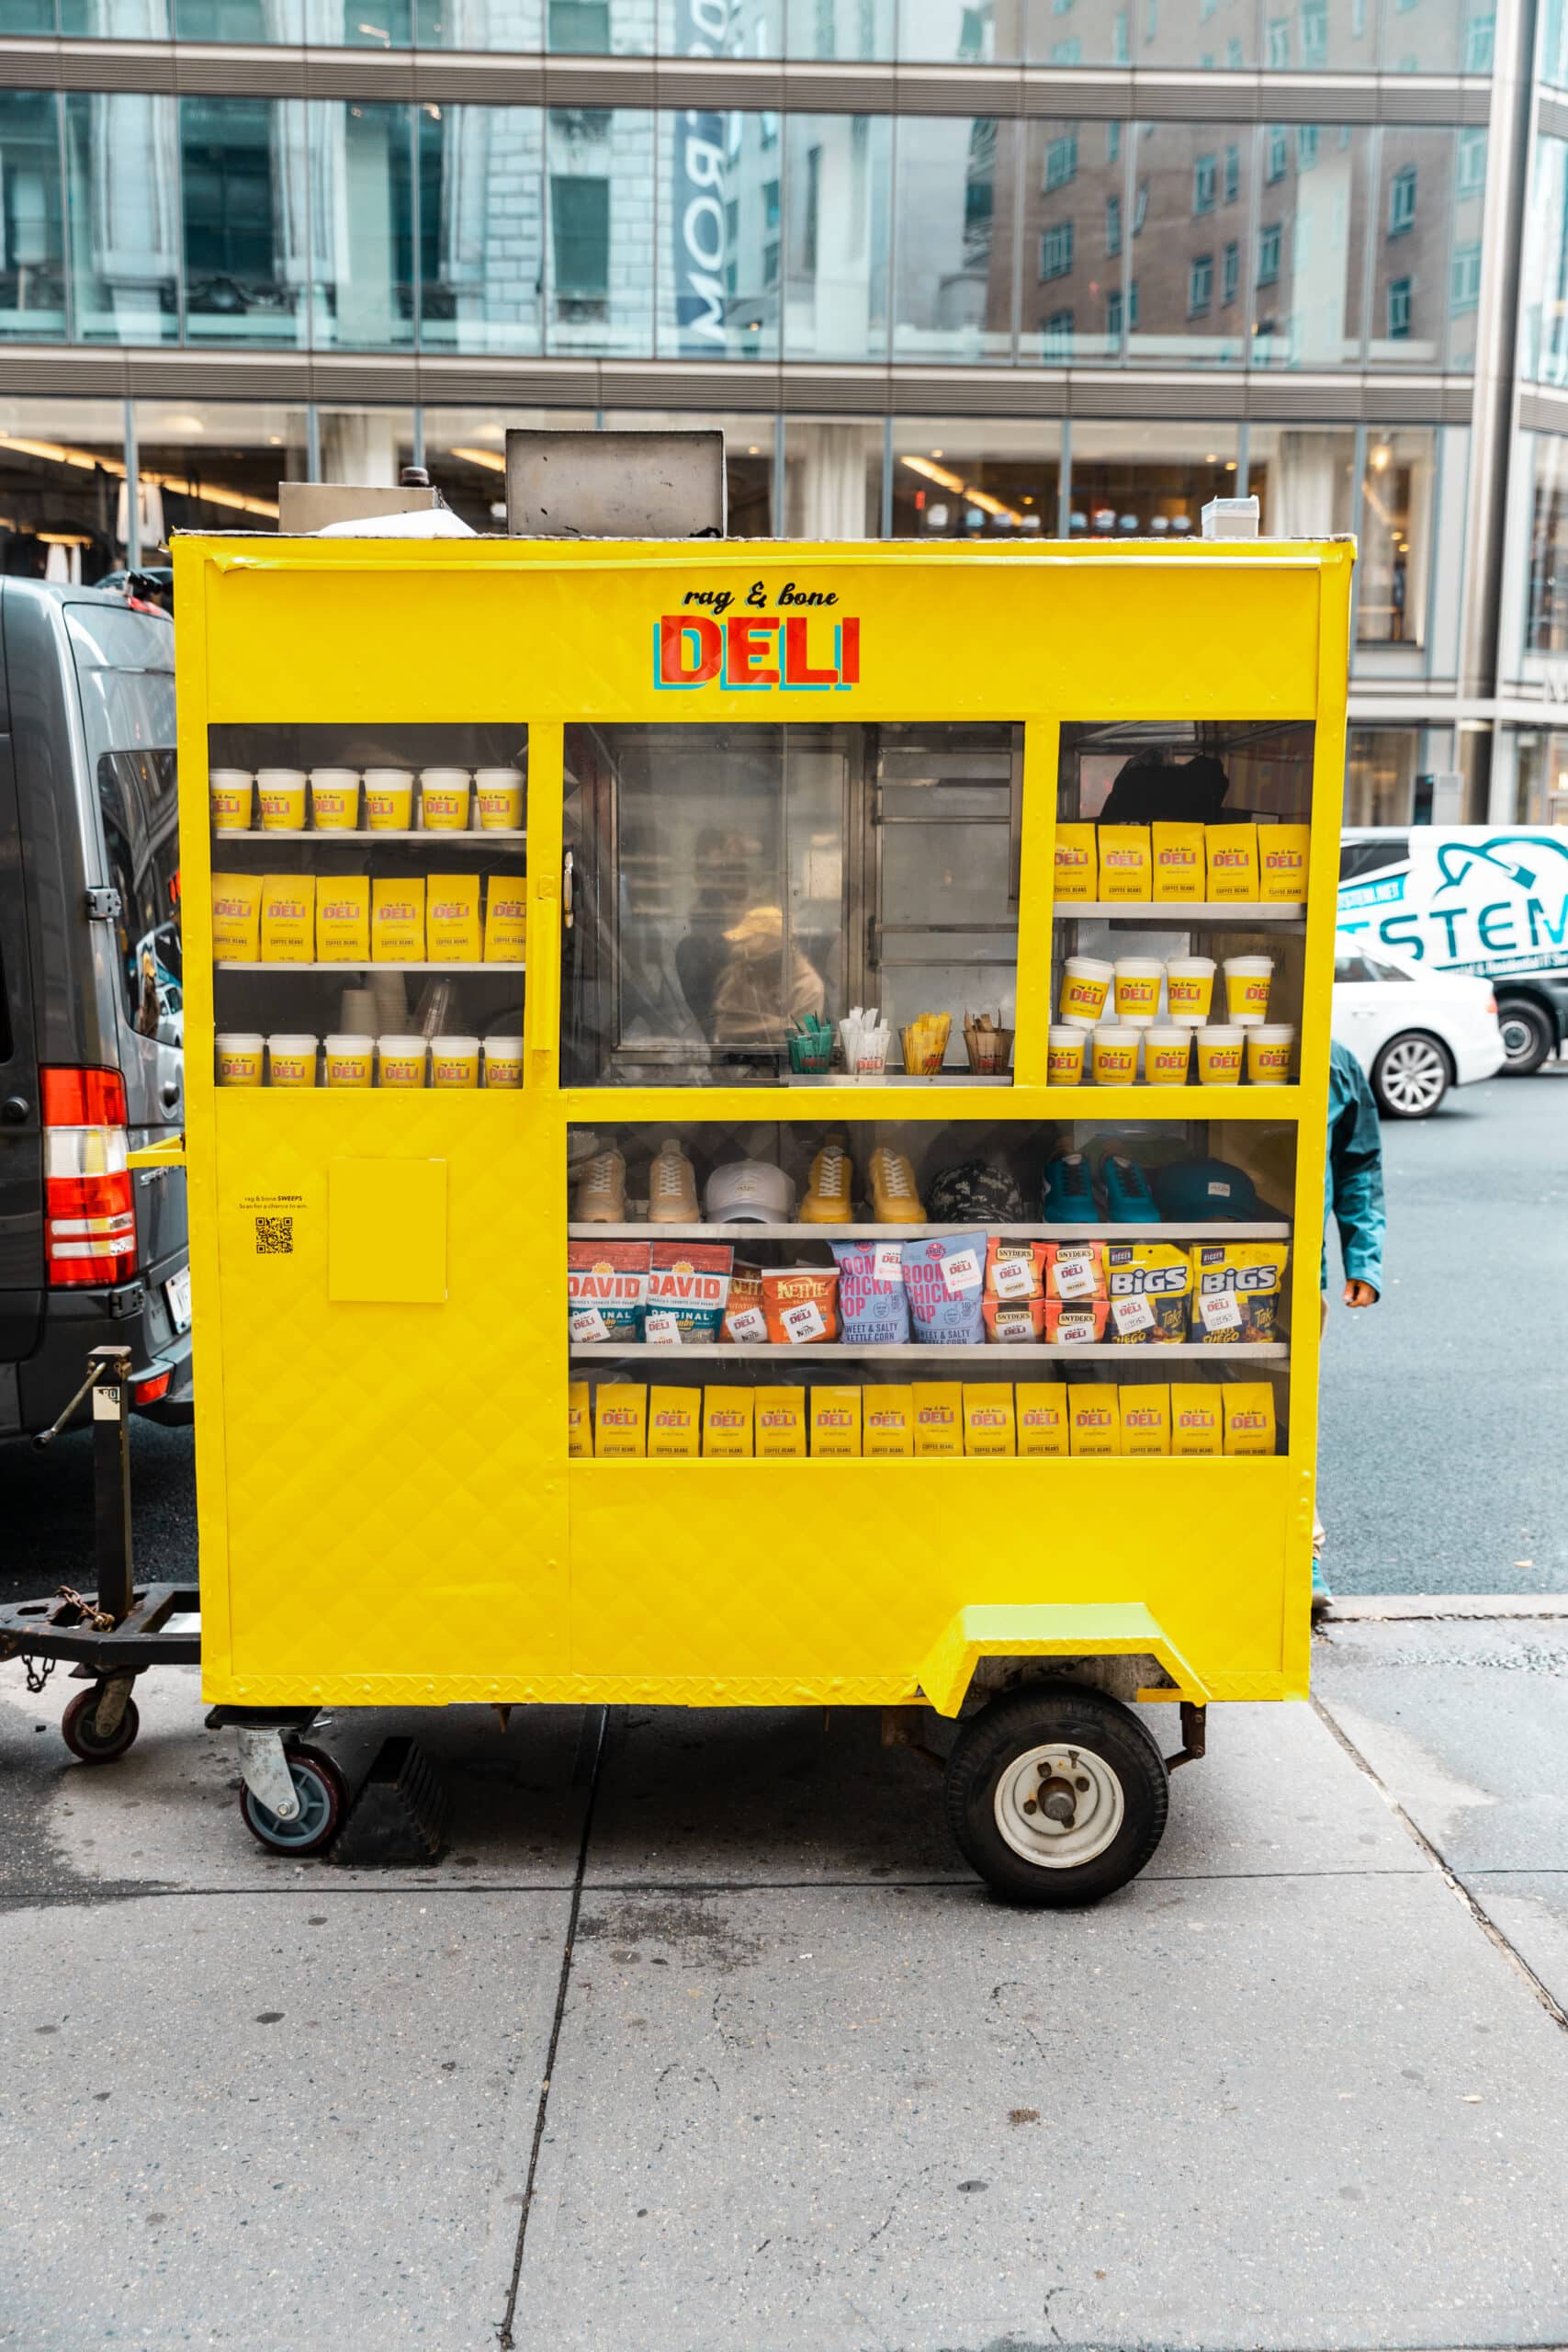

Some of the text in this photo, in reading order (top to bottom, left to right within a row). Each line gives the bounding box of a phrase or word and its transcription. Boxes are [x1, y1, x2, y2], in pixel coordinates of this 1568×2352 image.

[682, 581, 839, 616] rag & bone
[653, 615, 860, 691] DELI
[426, 800, 458, 814] DELI
[1121, 987, 1153, 1001] DELI
[1168, 987, 1201, 1001] DELI
[1099, 1056, 1132, 1069] DELI
[950, 1261, 972, 1275] DELI
[999, 1266, 1022, 1279] DELI
[1061, 1265, 1084, 1279] DELI
[568, 1276, 641, 1298] DAVID
[790, 1310, 812, 1325] DELI
[877, 1323, 897, 1332] SALTY
[948, 1329, 971, 1339] SALTY
[1065, 1329, 1087, 1340] DELI
[875, 1333, 895, 1341] CORN
[602, 1412, 637, 1427] DELI
[655, 1413, 691, 1428] DELI
[710, 1414, 745, 1428] DELI
[761, 1414, 796, 1428] DELI
[817, 1414, 852, 1427] DELI
[869, 1415, 906, 1429] DELI
[918, 1410, 953, 1424] DELI
[970, 1413, 1006, 1427] DELI
[1022, 1412, 1059, 1426] DELI
[1076, 1413, 1111, 1427] DELI
[1126, 1413, 1161, 1427] DELI
[1179, 1414, 1214, 1428] DELI
[1231, 1415, 1267, 1430] DELI
